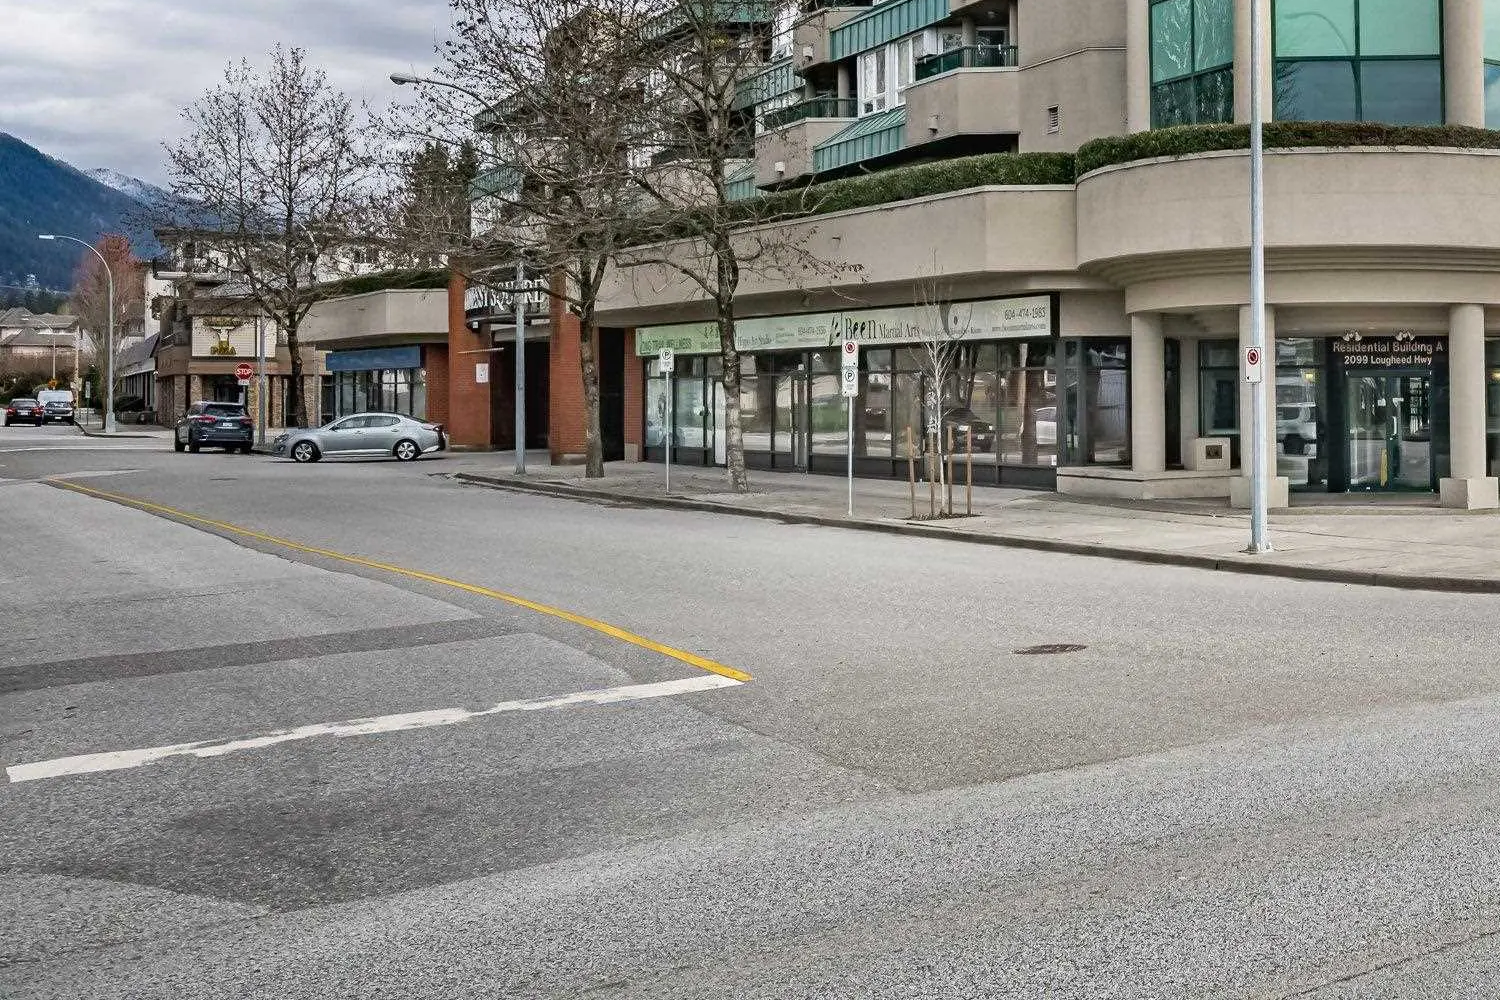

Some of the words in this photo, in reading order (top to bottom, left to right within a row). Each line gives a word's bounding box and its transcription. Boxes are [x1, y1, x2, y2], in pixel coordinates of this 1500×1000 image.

[845, 318, 877, 339] Been
[880, 322, 903, 339] Martial
[905, 323, 920, 338] Arts
[1333, 341, 1390, 352] Residential
[1392, 341, 1433, 354] Building
[1435, 342, 1443, 352] A
[1344, 355, 1368, 364] 2099
[1370, 355, 1412, 366] Lougheed
[1414, 356, 1432, 365] Hwy
[236, 368, 253, 376] STOP
